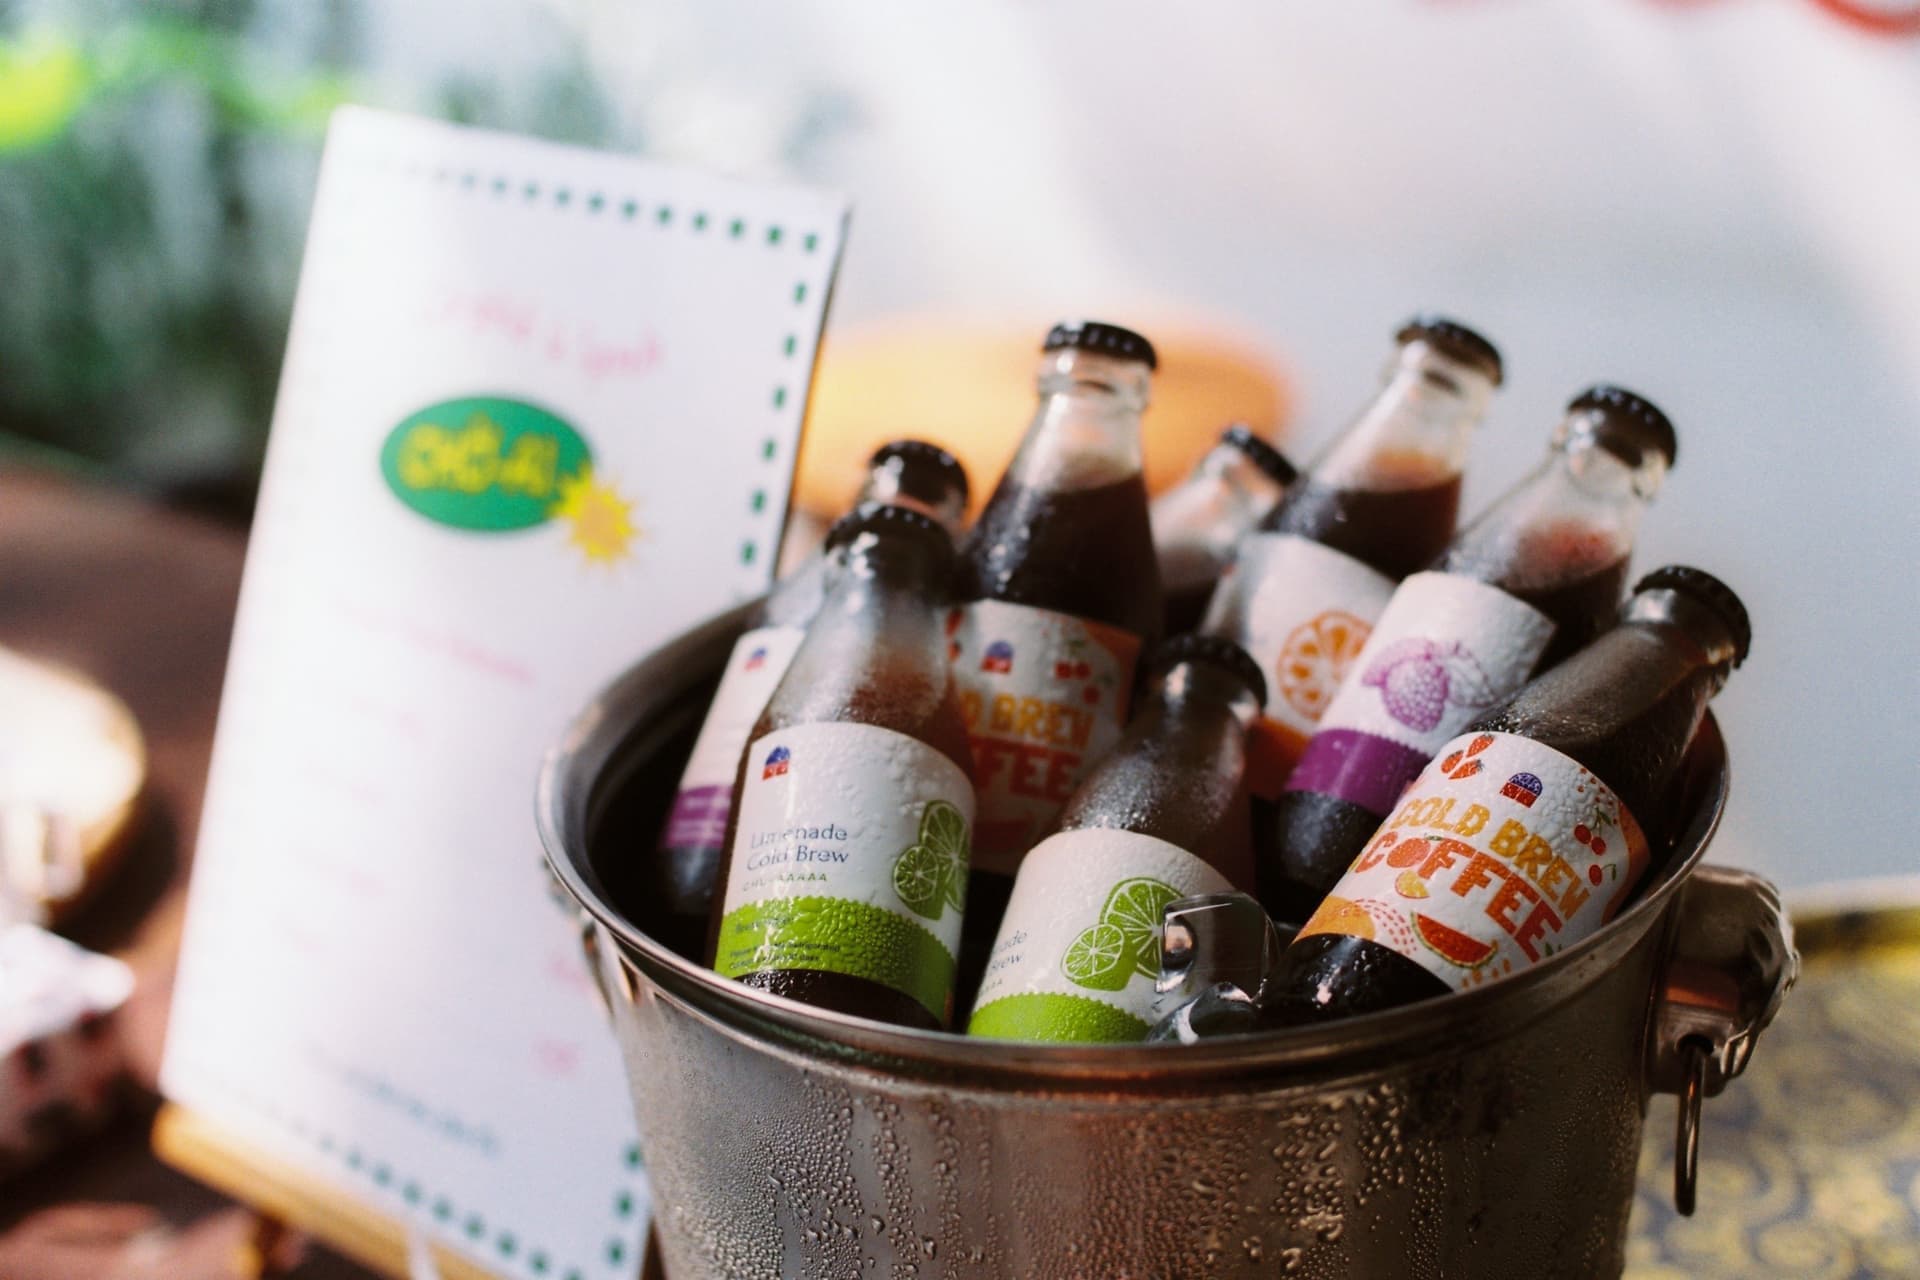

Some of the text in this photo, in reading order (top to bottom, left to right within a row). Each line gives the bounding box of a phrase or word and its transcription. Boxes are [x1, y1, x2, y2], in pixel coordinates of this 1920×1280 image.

[796, 844, 849, 863] Brew
[1355, 831, 1562, 963] COFFEE
[1390, 796, 1590, 920] COLD BREW
